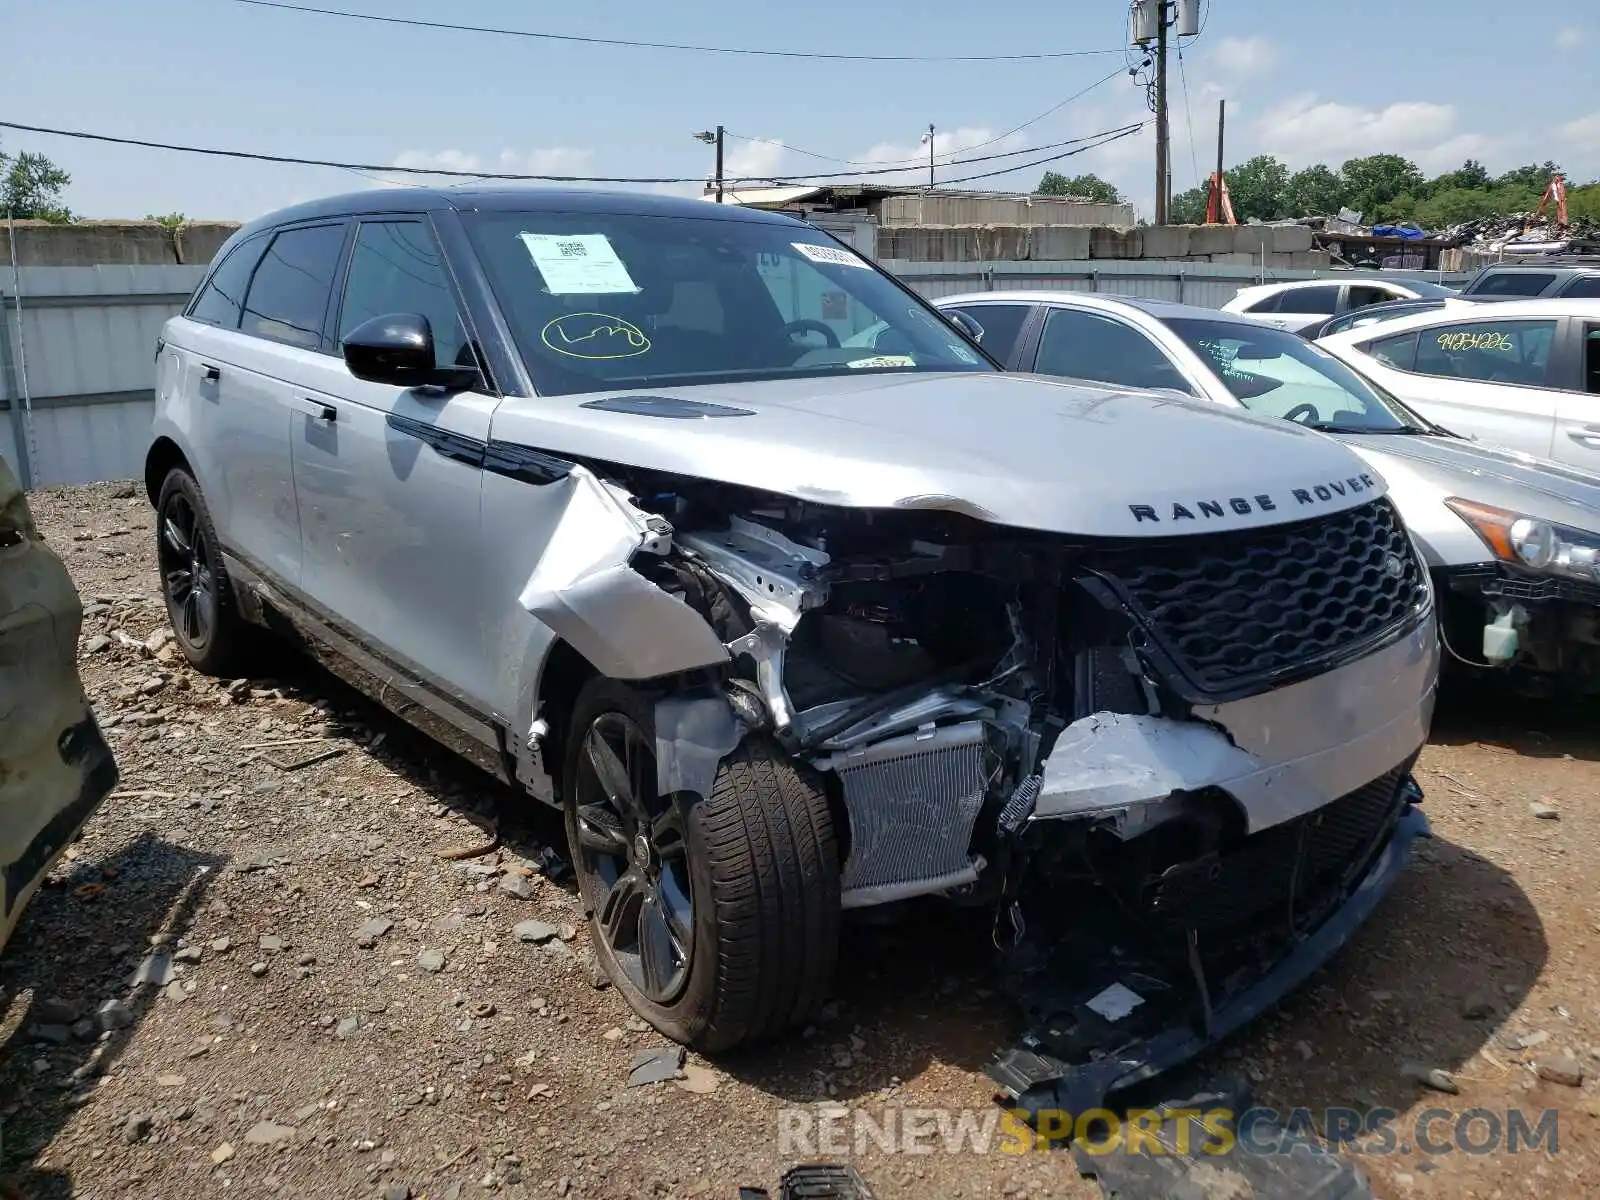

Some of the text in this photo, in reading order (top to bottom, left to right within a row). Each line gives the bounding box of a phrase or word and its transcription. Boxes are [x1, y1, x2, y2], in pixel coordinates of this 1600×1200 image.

[1437, 332, 1513, 351] 94254226
[1128, 472, 1375, 522] RANGE ROVER
